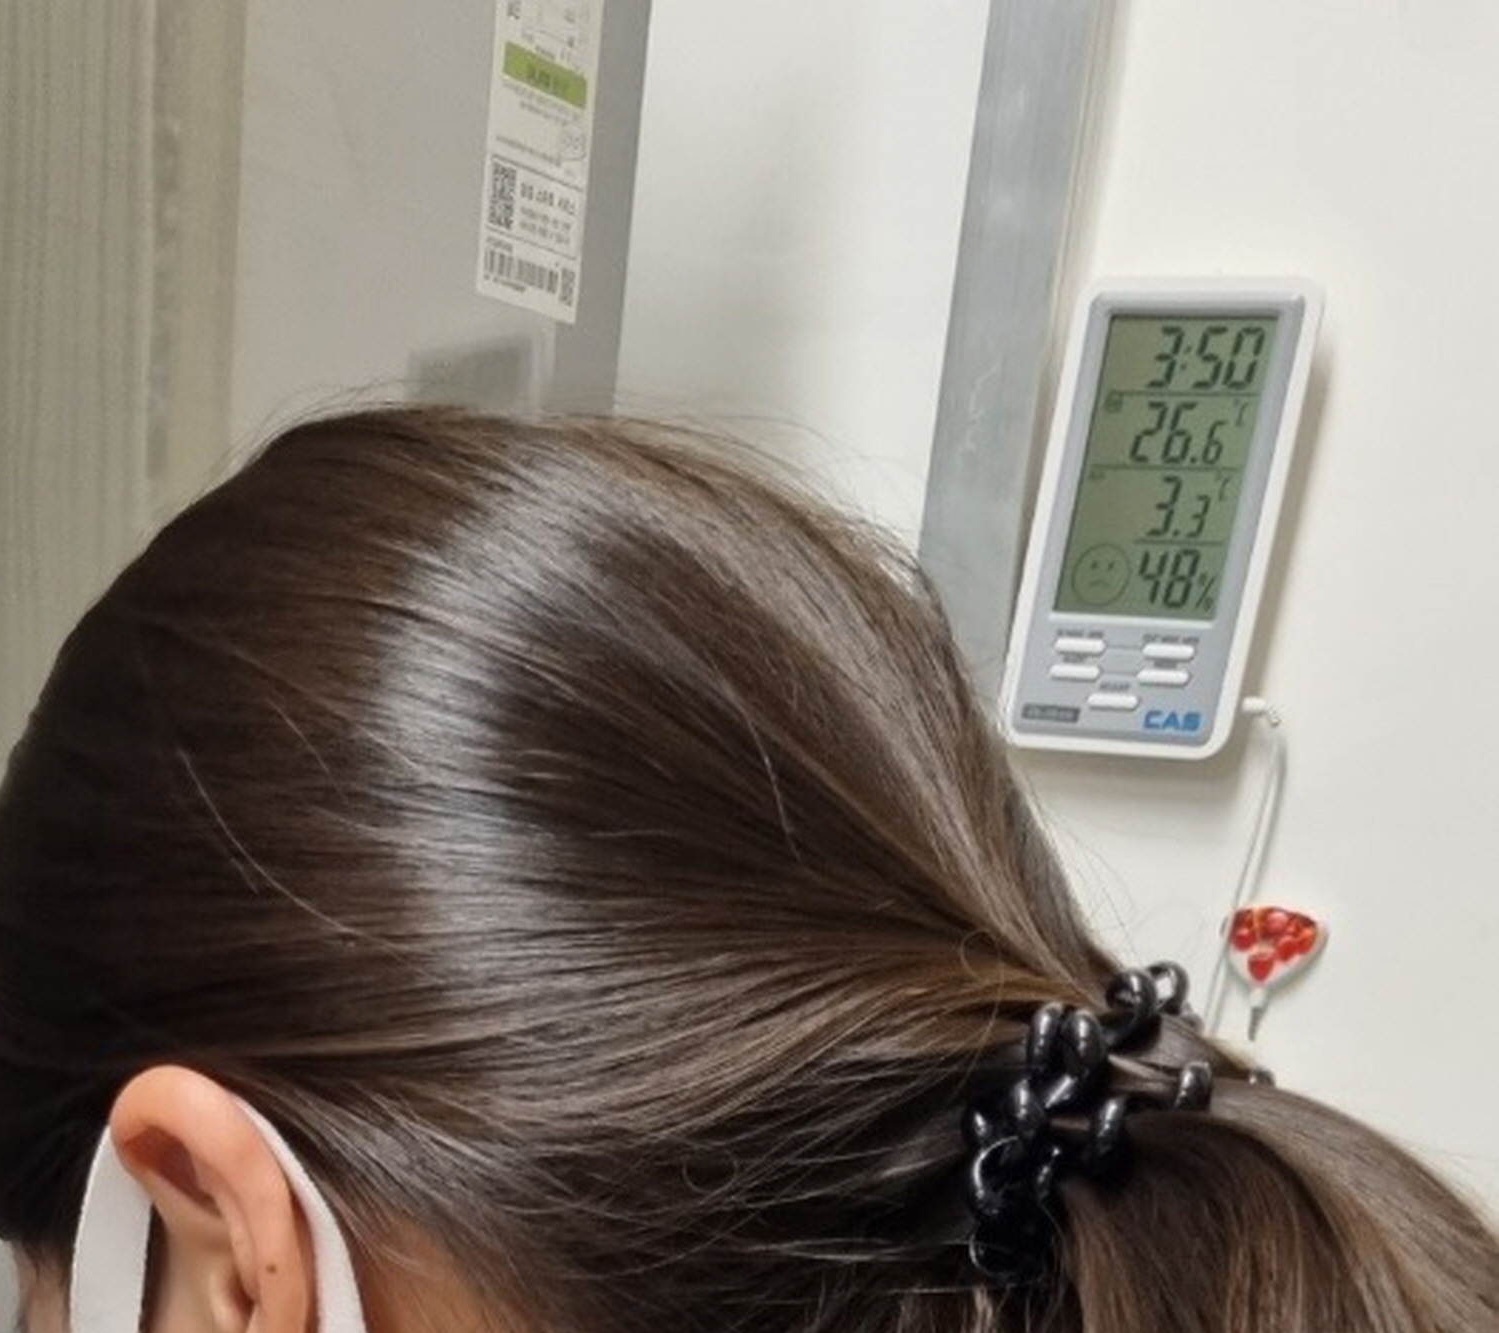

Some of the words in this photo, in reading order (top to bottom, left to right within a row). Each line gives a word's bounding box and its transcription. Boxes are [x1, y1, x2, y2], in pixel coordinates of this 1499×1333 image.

[1146, 325, 1266, 390] 3:50
[1128, 400, 1228, 465] 26.6
[1145, 474, 1211, 539] 3.3
[1143, 709, 1202, 731] CAS
